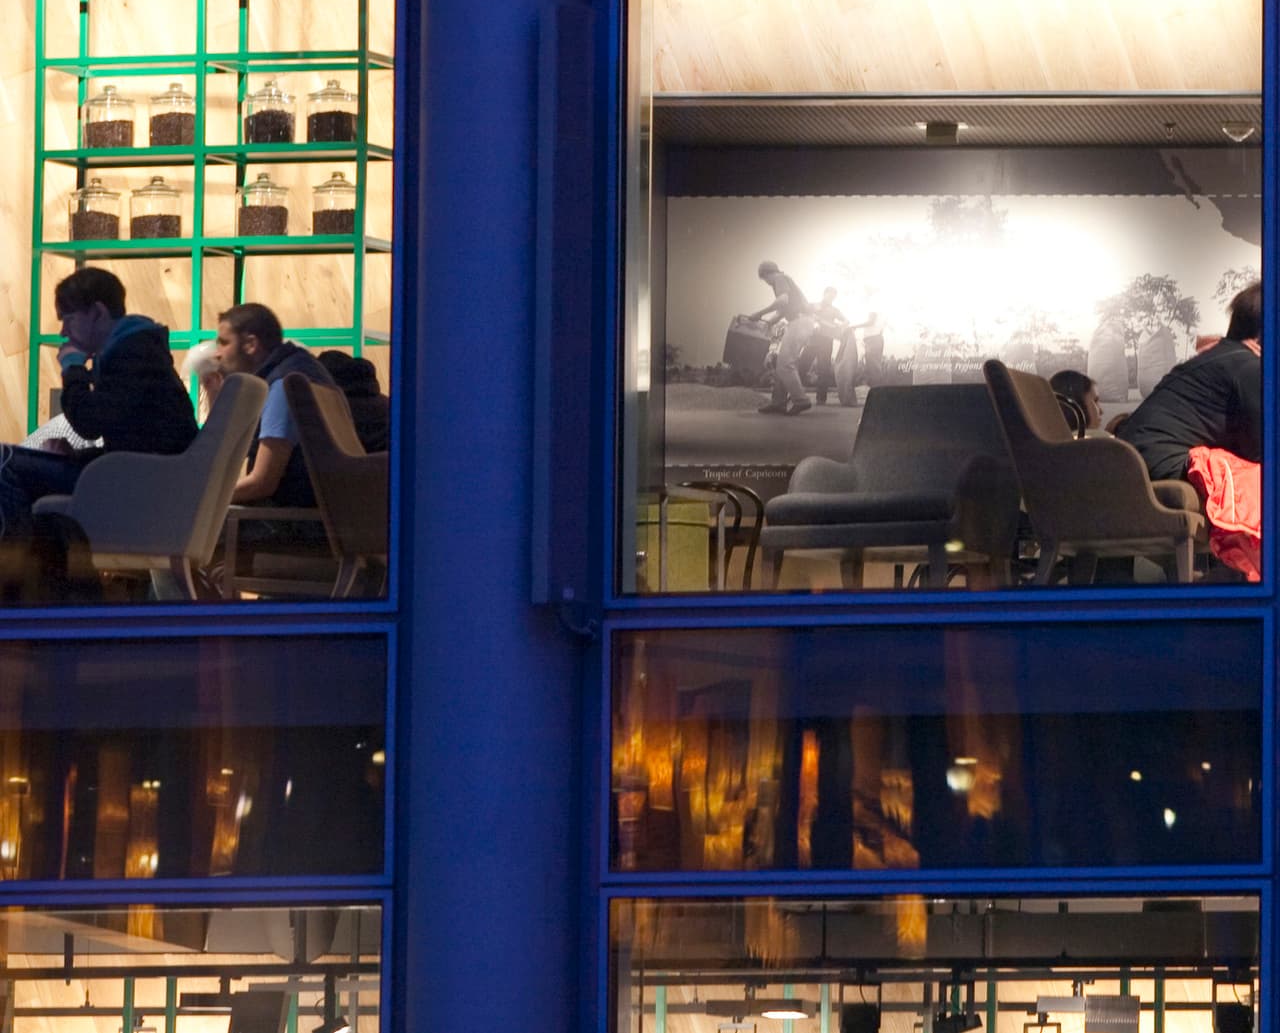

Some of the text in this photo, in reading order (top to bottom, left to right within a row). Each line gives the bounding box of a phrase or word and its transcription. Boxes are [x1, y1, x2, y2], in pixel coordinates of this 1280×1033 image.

[703, 468, 787, 481] Tropic of Capricorn
